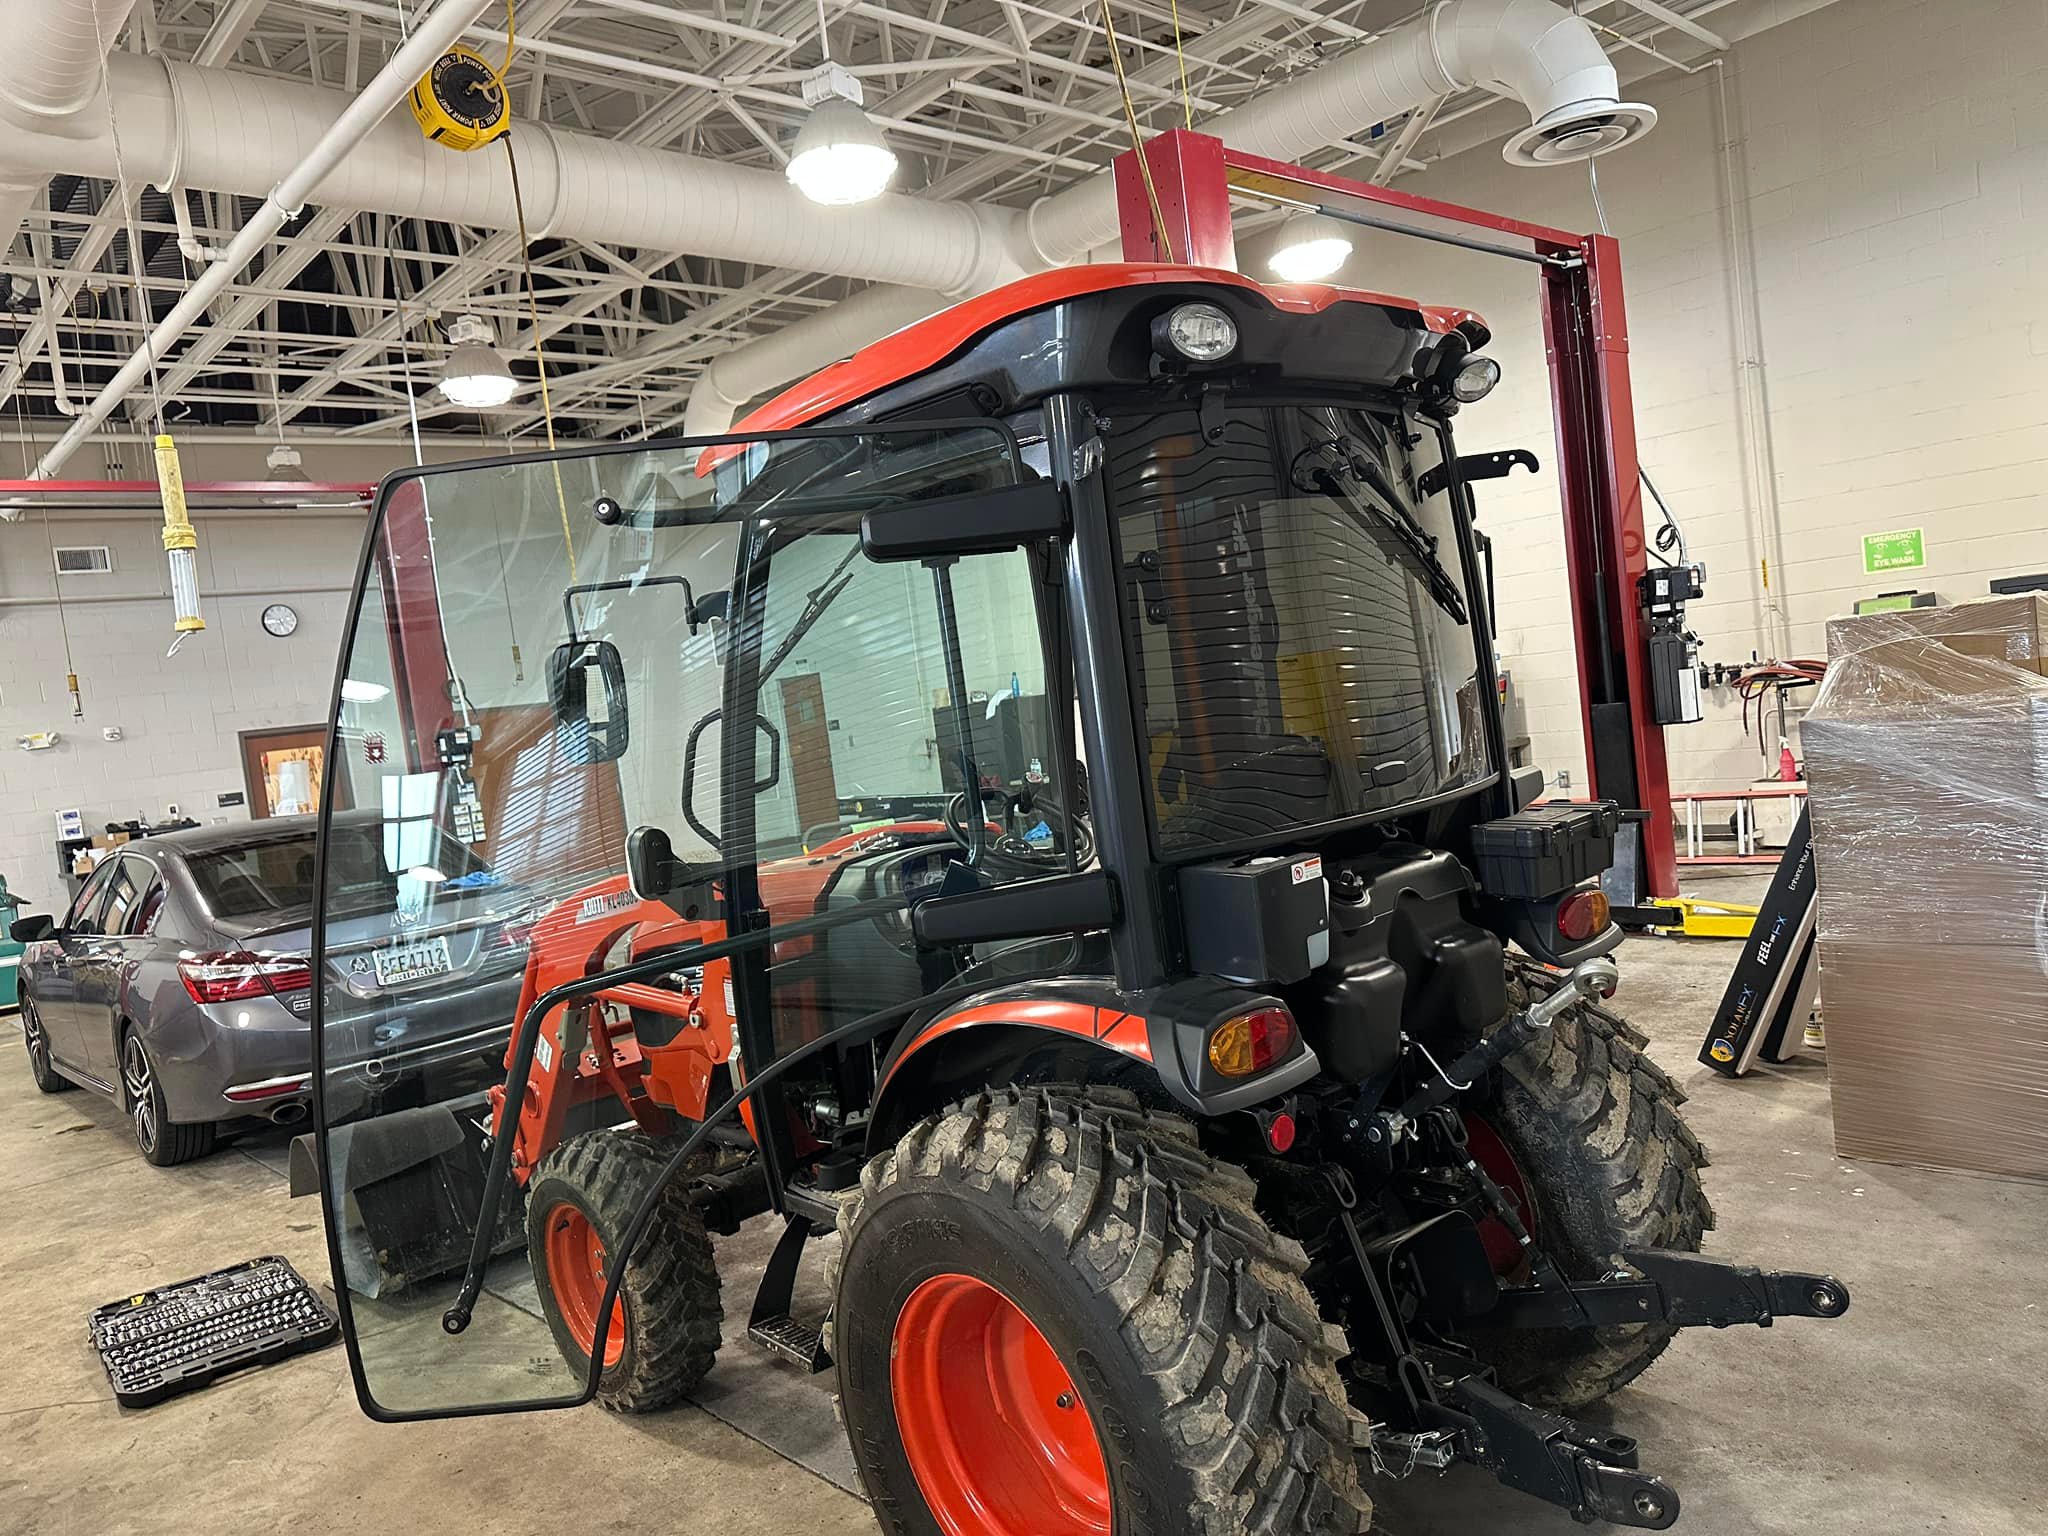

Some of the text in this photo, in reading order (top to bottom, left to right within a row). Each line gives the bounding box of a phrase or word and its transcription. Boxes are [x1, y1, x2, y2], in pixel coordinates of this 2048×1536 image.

[463, 57, 484, 71] POWER
[452, 112, 472, 126] POWER
[1868, 532, 1917, 544] EMERGENCY
[1874, 559, 1889, 567] EYE
[1890, 555, 1915, 564] WASH
[1788, 863, 1804, 890] Enhance
[1800, 849, 1810, 864] Your
[1757, 941, 1771, 965] FEEL
